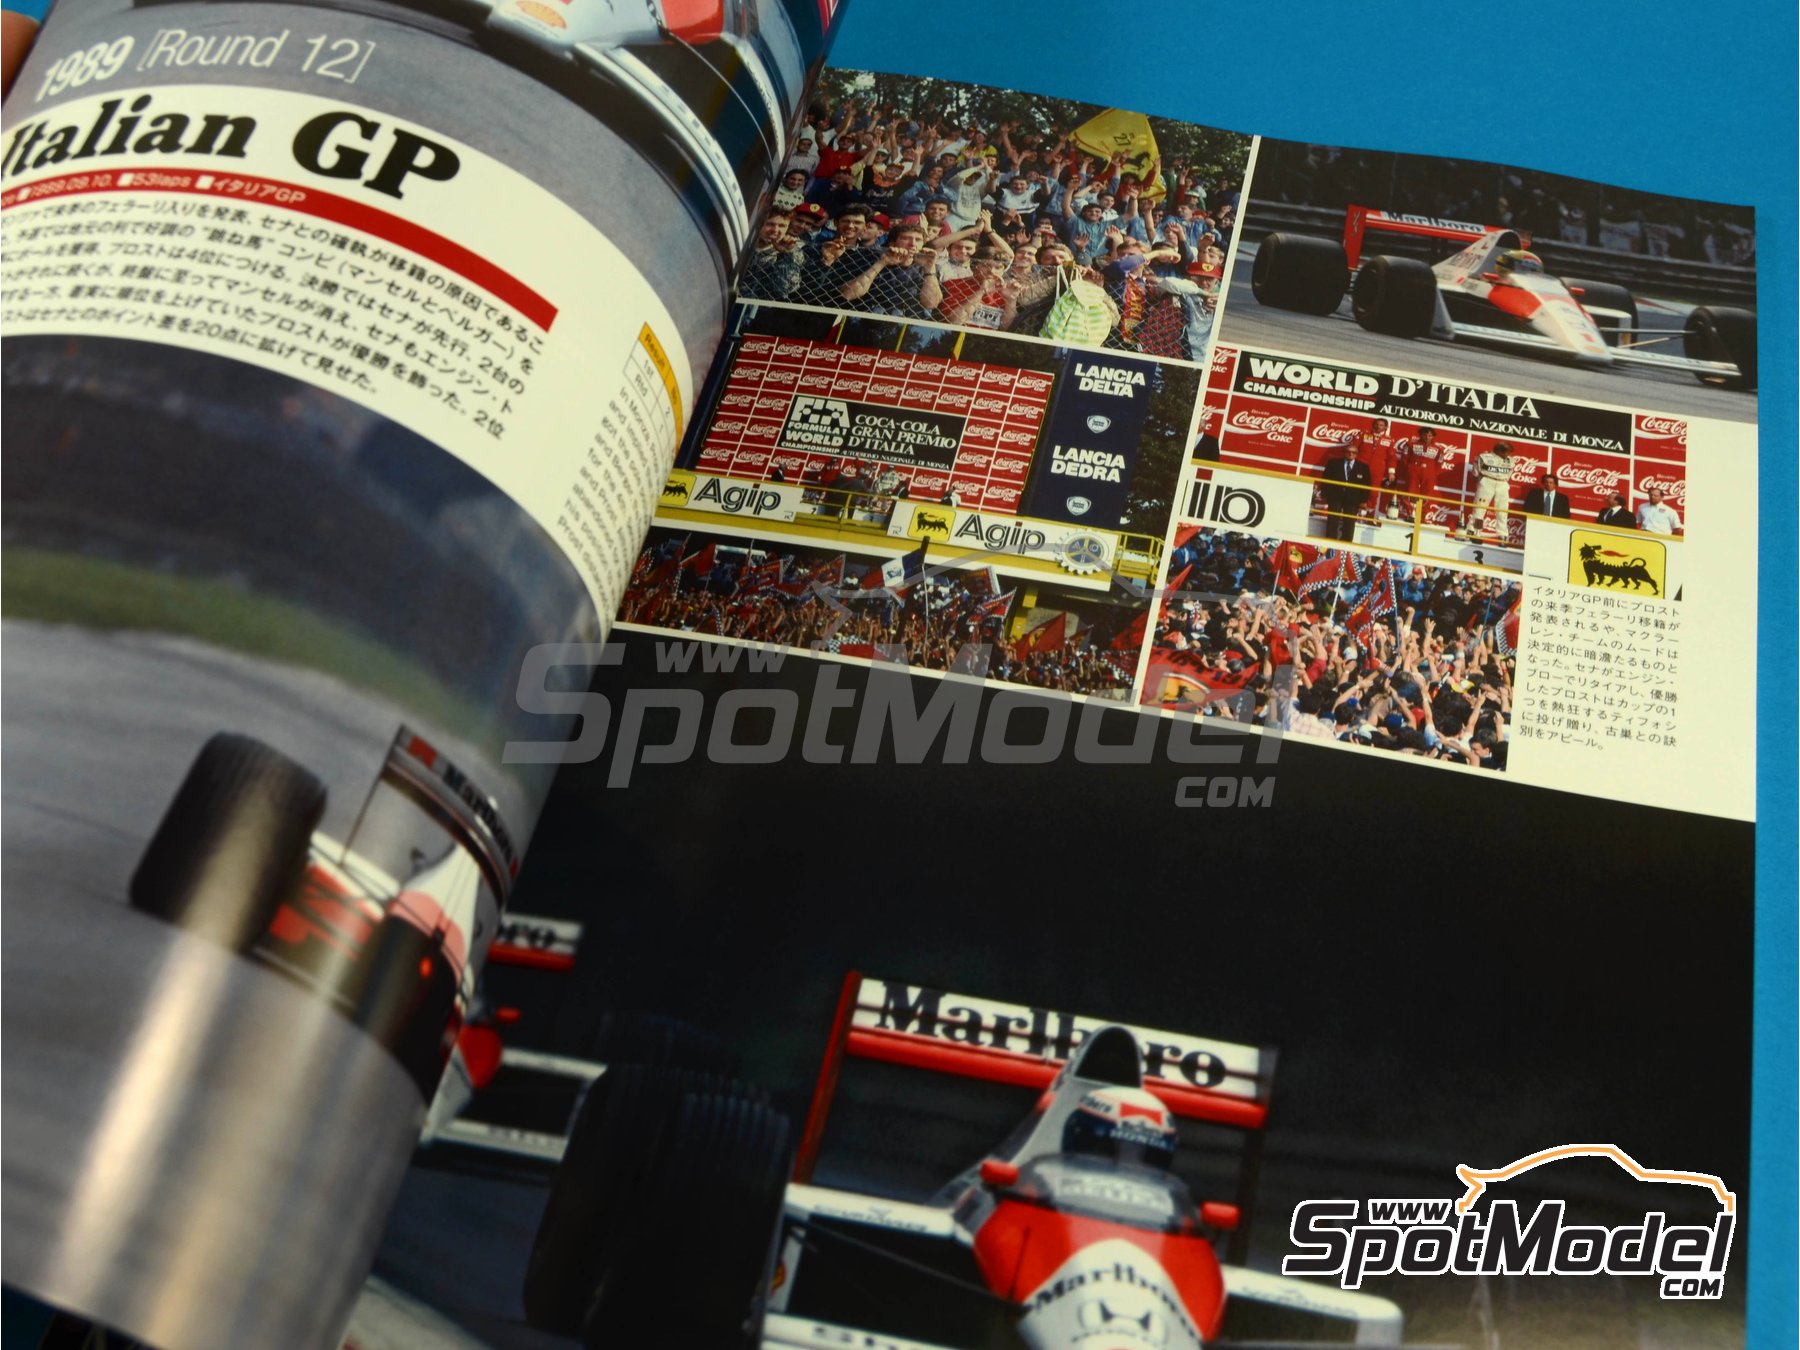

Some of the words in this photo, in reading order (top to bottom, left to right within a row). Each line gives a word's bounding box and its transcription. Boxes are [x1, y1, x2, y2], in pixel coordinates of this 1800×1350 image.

[35, 35, 135, 102] 1989
[137, 28, 290, 72] [Round
[300, 34, 376, 83] 12]
[2, 94, 258, 182] Italian
[292, 111, 461, 200] GP
[1387, 211, 1484, 233] Marlboro
[1074, 363, 1146, 386] LANCIA
[1079, 377, 1134, 398] DELTA
[1249, 357, 1379, 395] WORLD
[1389, 375, 1541, 419] D’ITALIA
[787, 421, 841, 435] FORMULA
[855, 414, 940, 435] COCA-COLA
[1232, 410, 1297, 434] Coca-Cola
[1243, 381, 1376, 411] CHAMPIONSHIP
[1379, 406, 1464, 426] AUTODROMO
[1469, 417, 1548, 440] NAZIONALE
[1553, 432, 1568, 442] DI
[1572, 434, 1625, 451] MONZA
[781, 441, 840, 454] CHAMPIONSHIP
[785, 430, 844, 447] WORLD
[847, 435, 914, 455] D’ITALIA
[851, 425, 895, 440] GRAN
[897, 431, 957, 449] PREMIO
[1266, 432, 1293, 443] Coke
[926, 462, 950, 470] MONZA
[1052, 445, 1126, 469] LANCIA
[1050, 459, 1121, 483] DEDRA
[1511, 472, 1537, 484] Coke
[1556, 463, 1620, 487] Coca-Cola
[694, 477, 782, 515] Agip
[954, 513, 1046, 554] Agip
[1533, 585, 1680, 617] イタリアGP前にプロスト
[1529, 611, 1680, 643] 発表されるや、マクラー
[1531, 599, 1680, 631] の来季フェラーリ移籍が
[1529, 626, 1679, 659] レン・チームのムードは
[1527, 653, 1675, 685] なった。セナがエンジン・
[1526, 667, 1678, 703] ブローでリタイアし、優勝
[1526, 681, 1676, 717] したプロストはカップの1
[1523, 697, 1676, 731] つを熱狂するティフォシ
[1519, 725, 1604, 751] 別をアピール。
[874, 980, 1227, 1088] Marlbro
